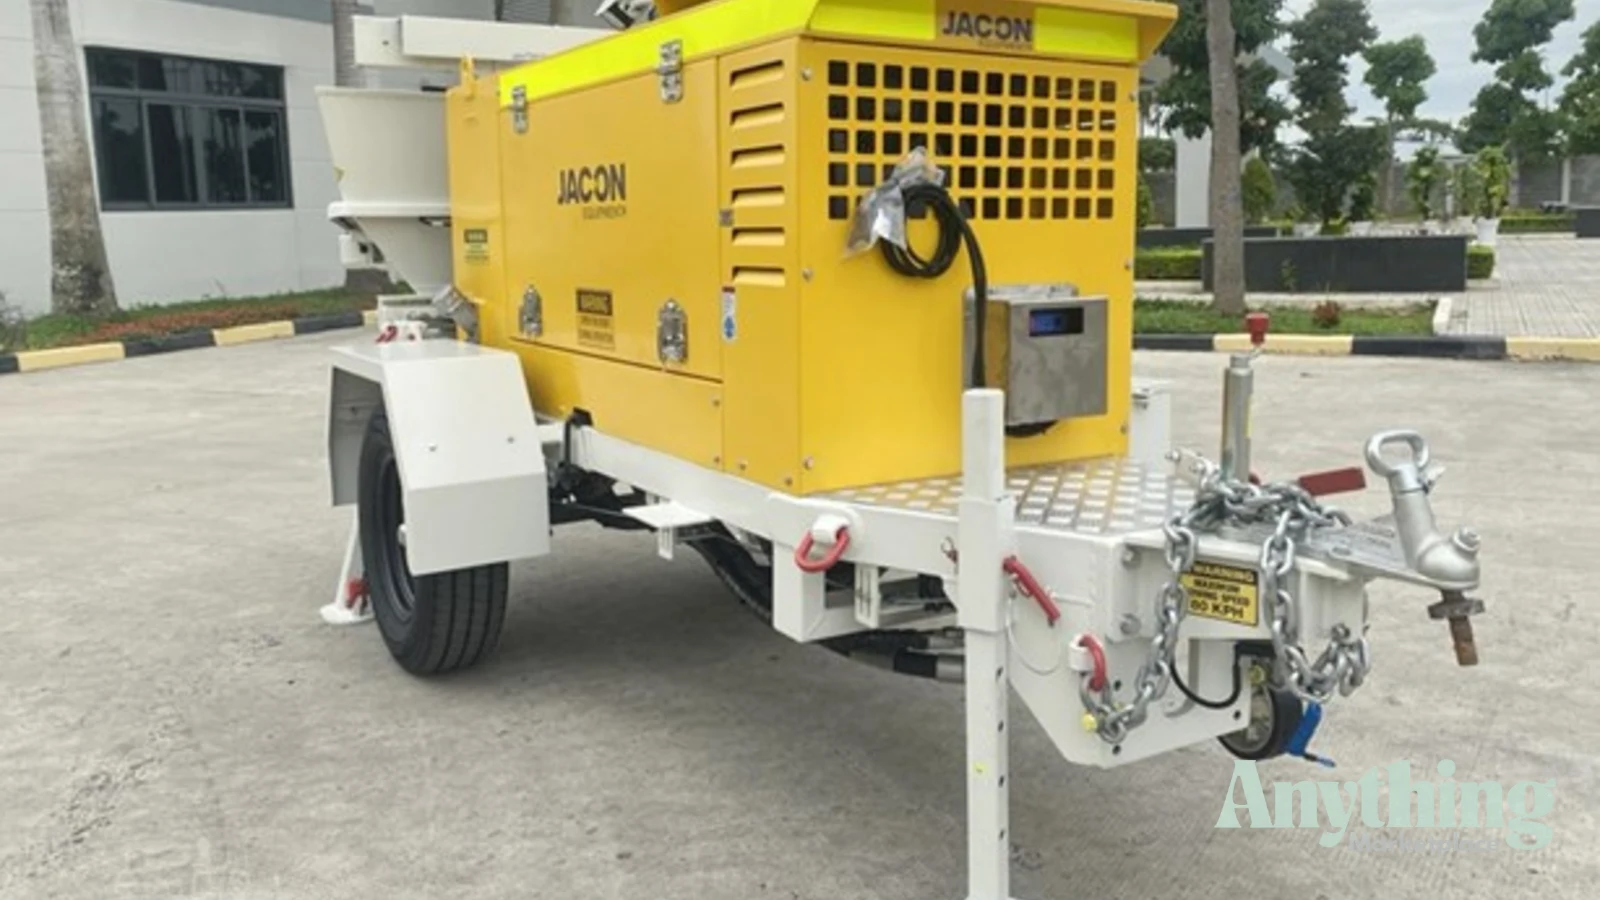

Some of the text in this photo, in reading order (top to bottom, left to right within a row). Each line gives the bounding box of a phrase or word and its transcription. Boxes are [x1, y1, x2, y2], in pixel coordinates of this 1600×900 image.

[942, 11, 1033, 42] JACON
[557, 162, 626, 205] JACON
[1193, 565, 1254, 582] WARNING
[1193, 579, 1240, 593] MAXIMUM
[1222, 594, 1250, 608] SPEED
[1211, 603, 1244, 618] KPH
